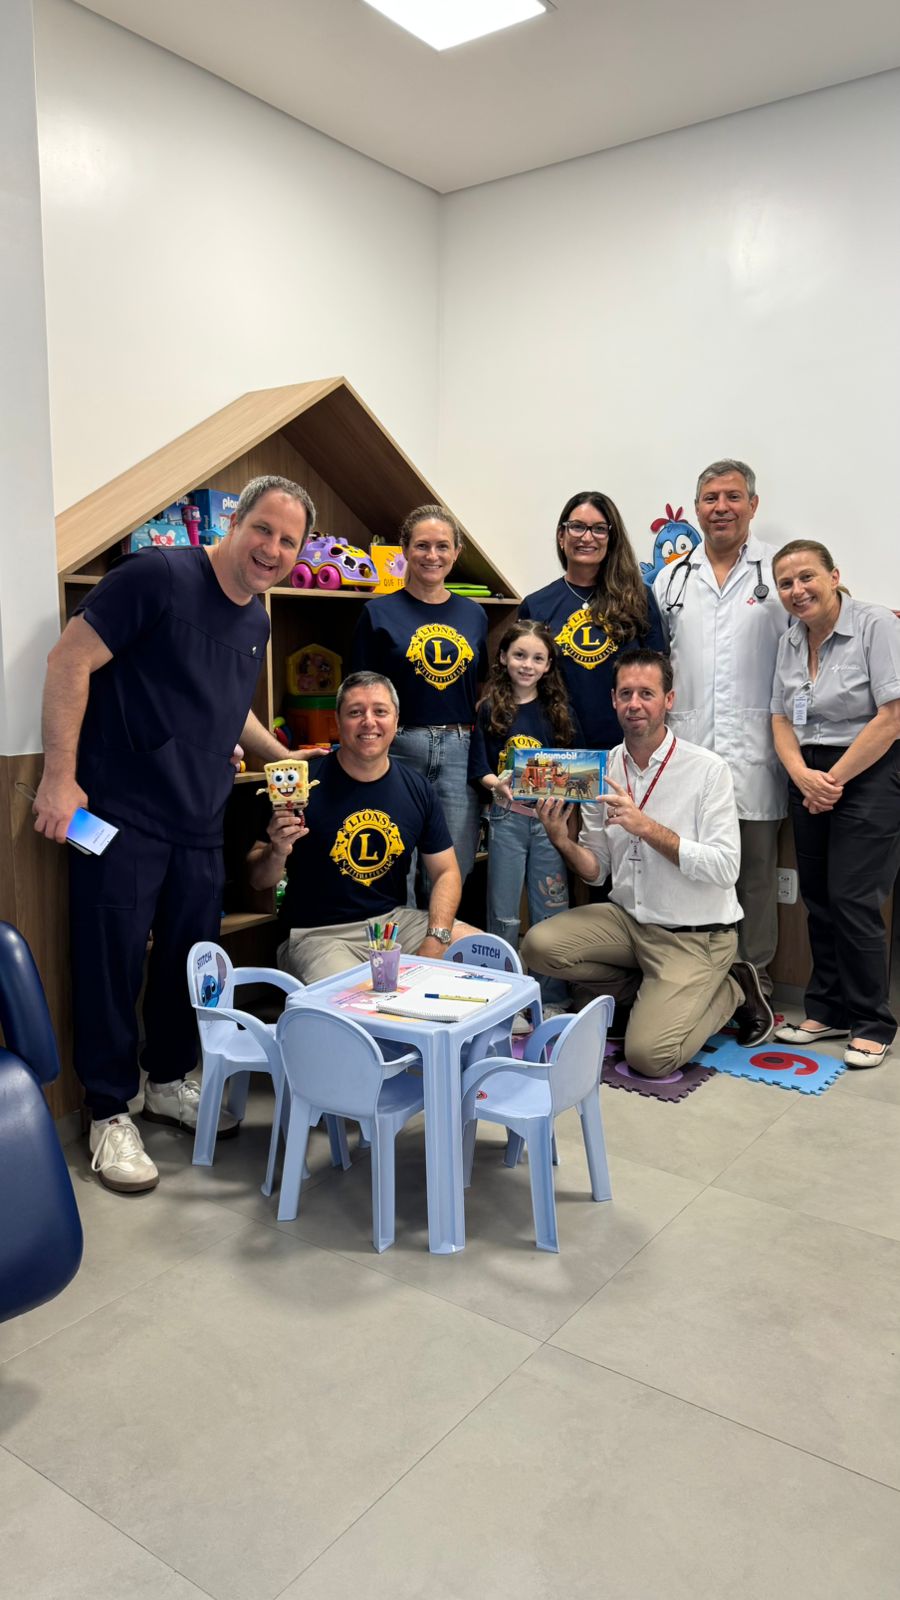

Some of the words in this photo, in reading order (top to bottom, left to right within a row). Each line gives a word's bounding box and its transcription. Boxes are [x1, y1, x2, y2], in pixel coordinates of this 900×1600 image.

[420, 625, 455, 636] LIONS
[581, 626, 600, 646] L
[431, 640, 452, 664] L
[534, 751, 577, 761] playmobil
[348, 812, 388, 828] LIONS
[358, 833, 379, 860] L
[197, 950, 213, 970] STITCH
[471, 943, 501, 960] STITCH
